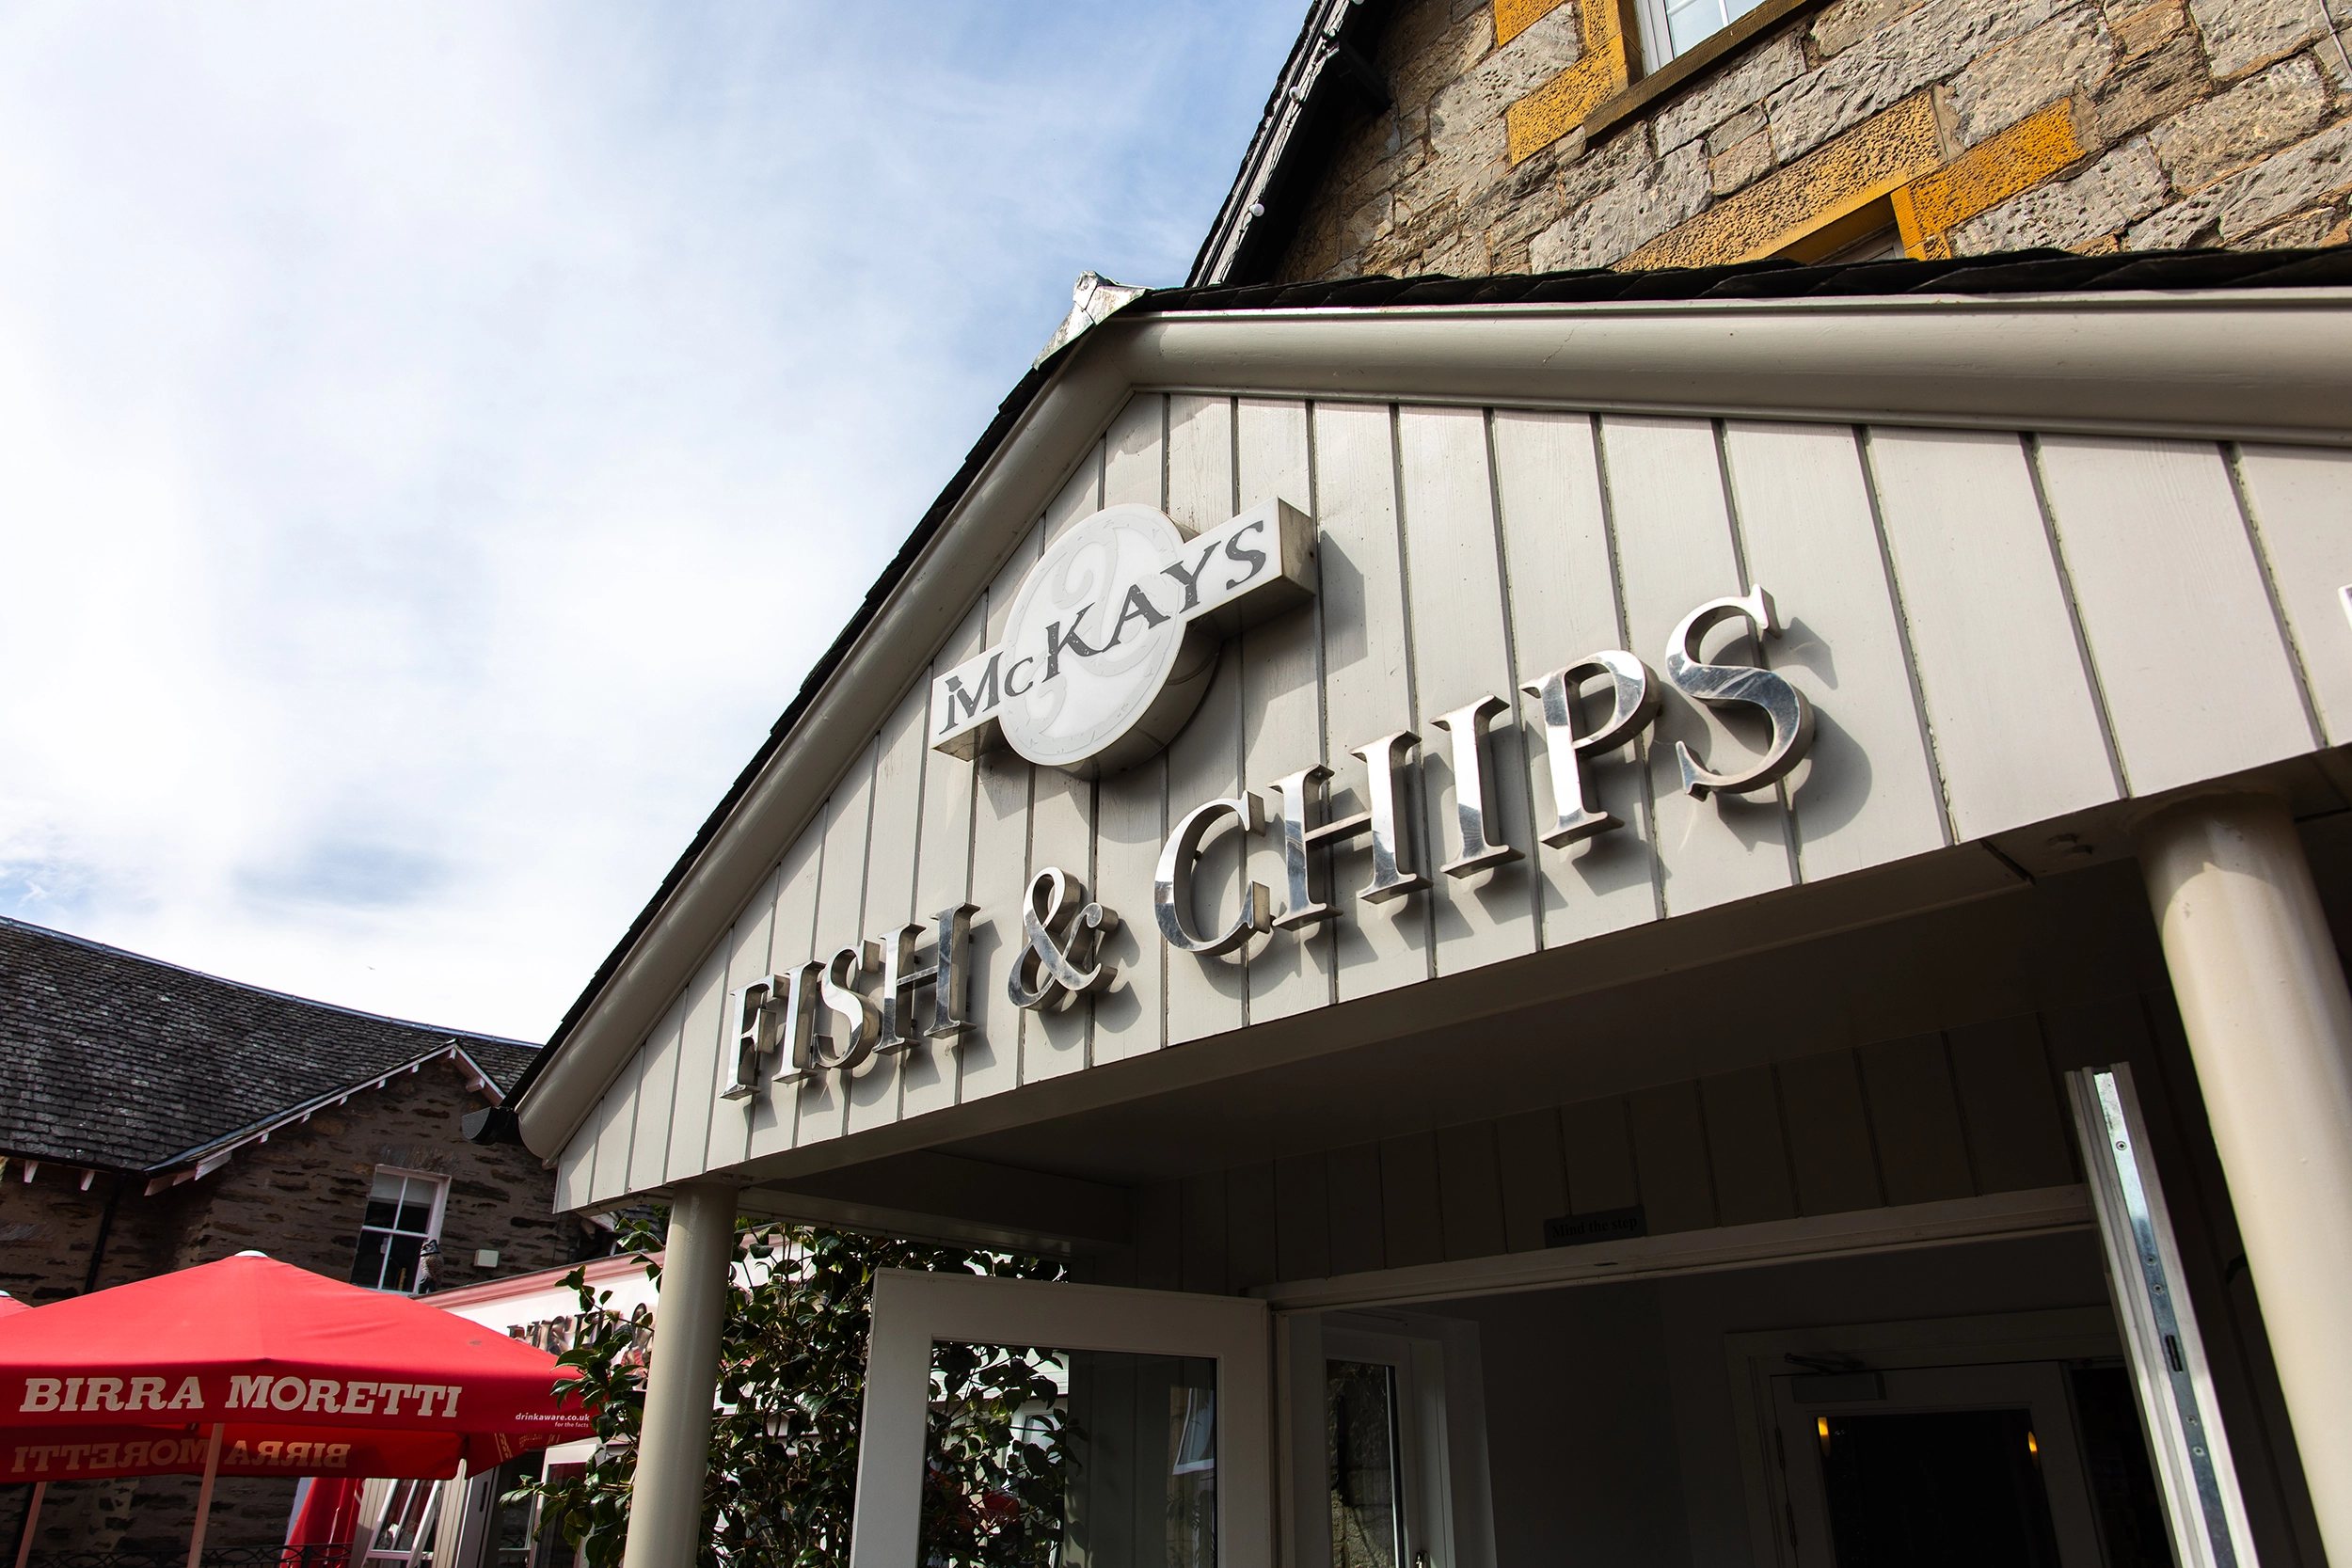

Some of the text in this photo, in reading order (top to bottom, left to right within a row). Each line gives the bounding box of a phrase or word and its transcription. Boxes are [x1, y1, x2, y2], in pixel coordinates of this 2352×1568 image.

[719, 583, 1816, 1101] FISH & CHIPS
[1551, 1217, 1638, 1238] Mind the step
[19, 1375, 463, 1418] BIRRA MORETTI
[515, 1413, 590, 1421] drinkaware.co.uk
